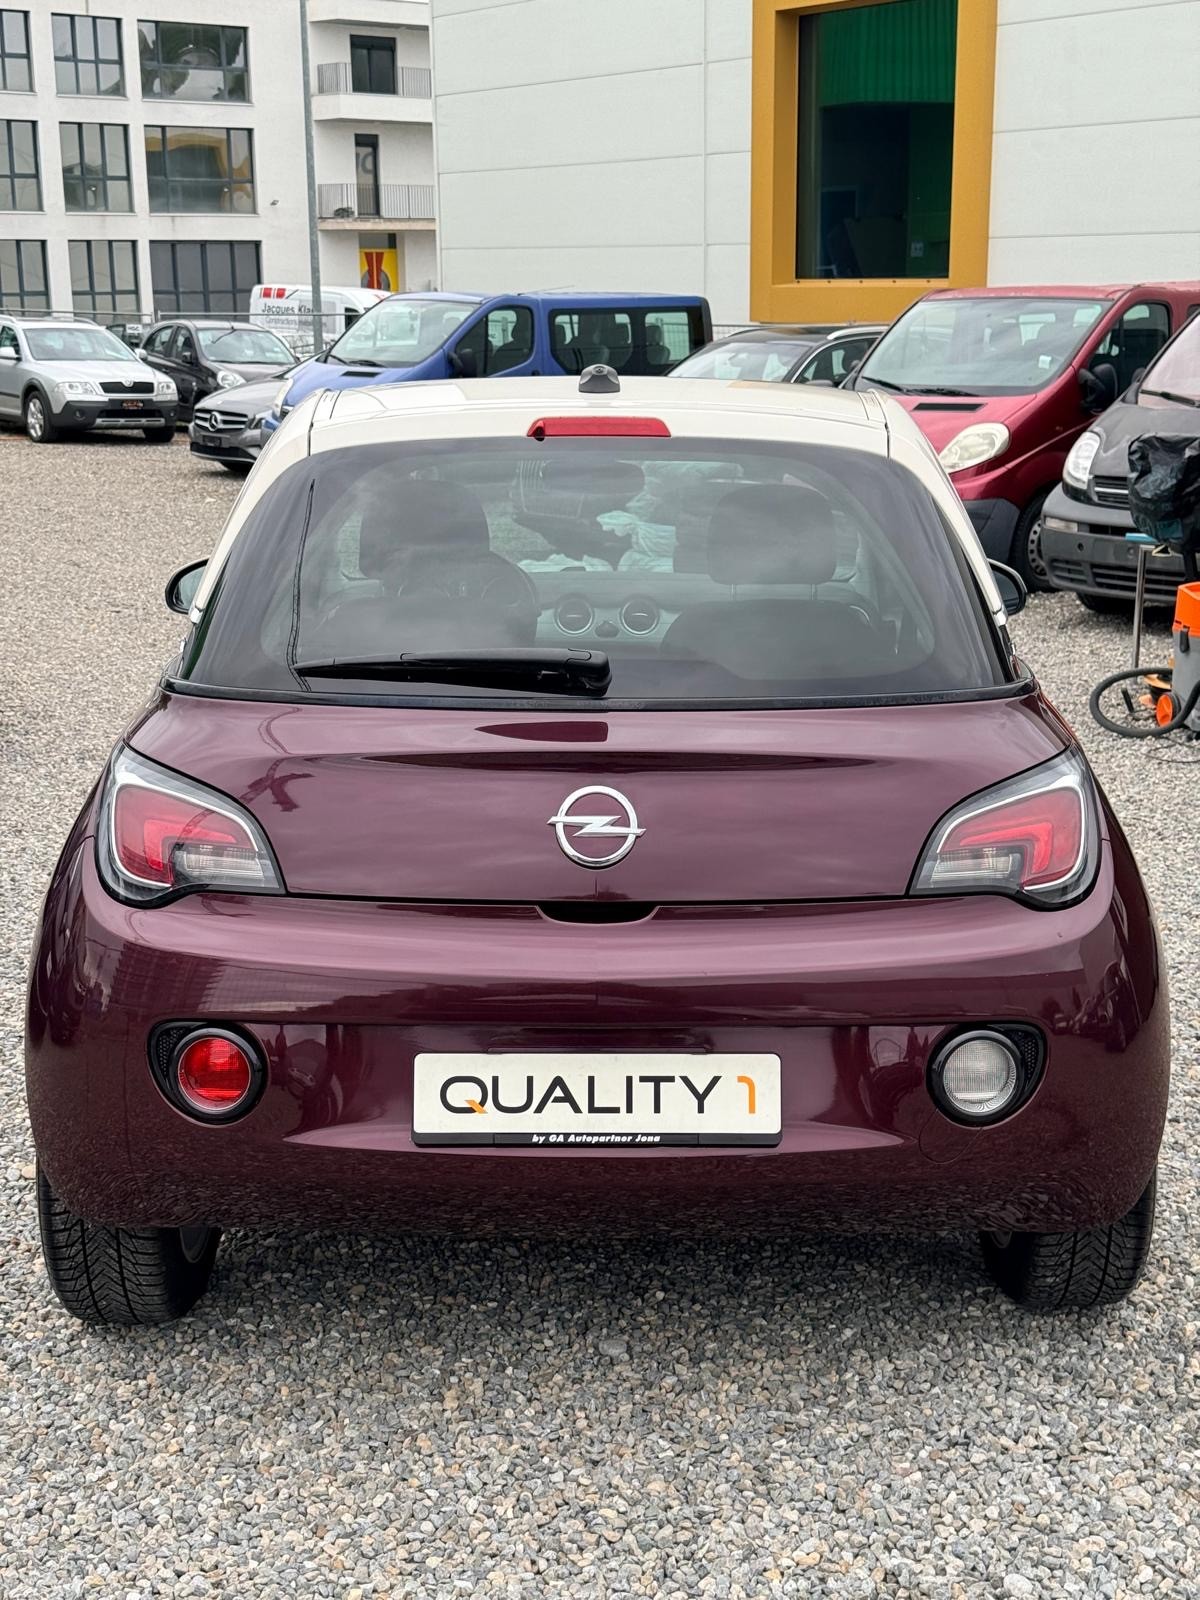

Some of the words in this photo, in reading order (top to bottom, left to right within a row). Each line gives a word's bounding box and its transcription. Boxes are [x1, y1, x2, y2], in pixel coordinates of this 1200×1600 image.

[262, 303, 295, 314] Jacques
[439, 1075, 722, 1114] QUALITY
[737, 1075, 756, 1114] 1
[532, 1134, 546, 1144] by
[549, 1134, 564, 1143] GA
[568, 1134, 633, 1144] Autopartner
[635, 1134, 661, 1143] Jona
